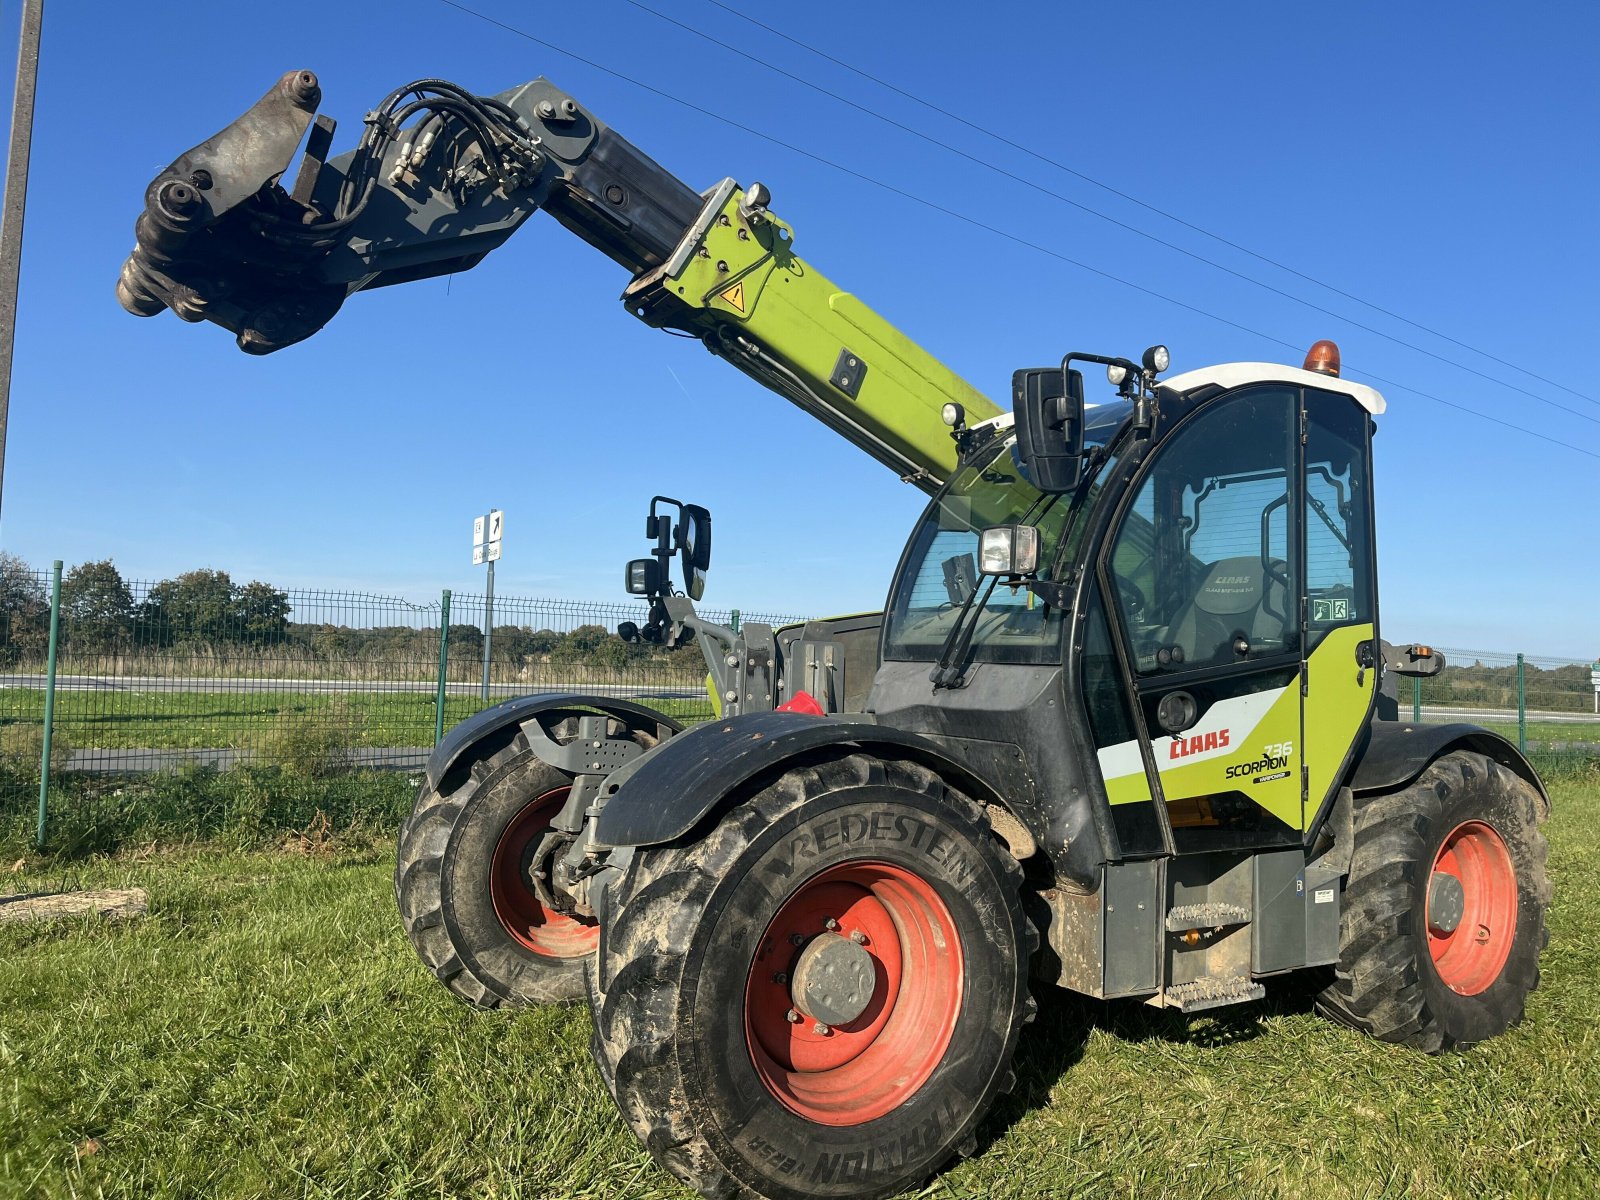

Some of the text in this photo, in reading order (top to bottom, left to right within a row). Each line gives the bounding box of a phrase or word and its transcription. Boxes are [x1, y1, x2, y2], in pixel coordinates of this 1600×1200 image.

[1215, 576, 1251, 584] CLAAS
[1170, 729, 1229, 760] CLAAS
[1264, 741, 1293, 760] 736
[1225, 755, 1288, 780] SCORPION
[763, 811, 978, 885] VREDESTEIN
